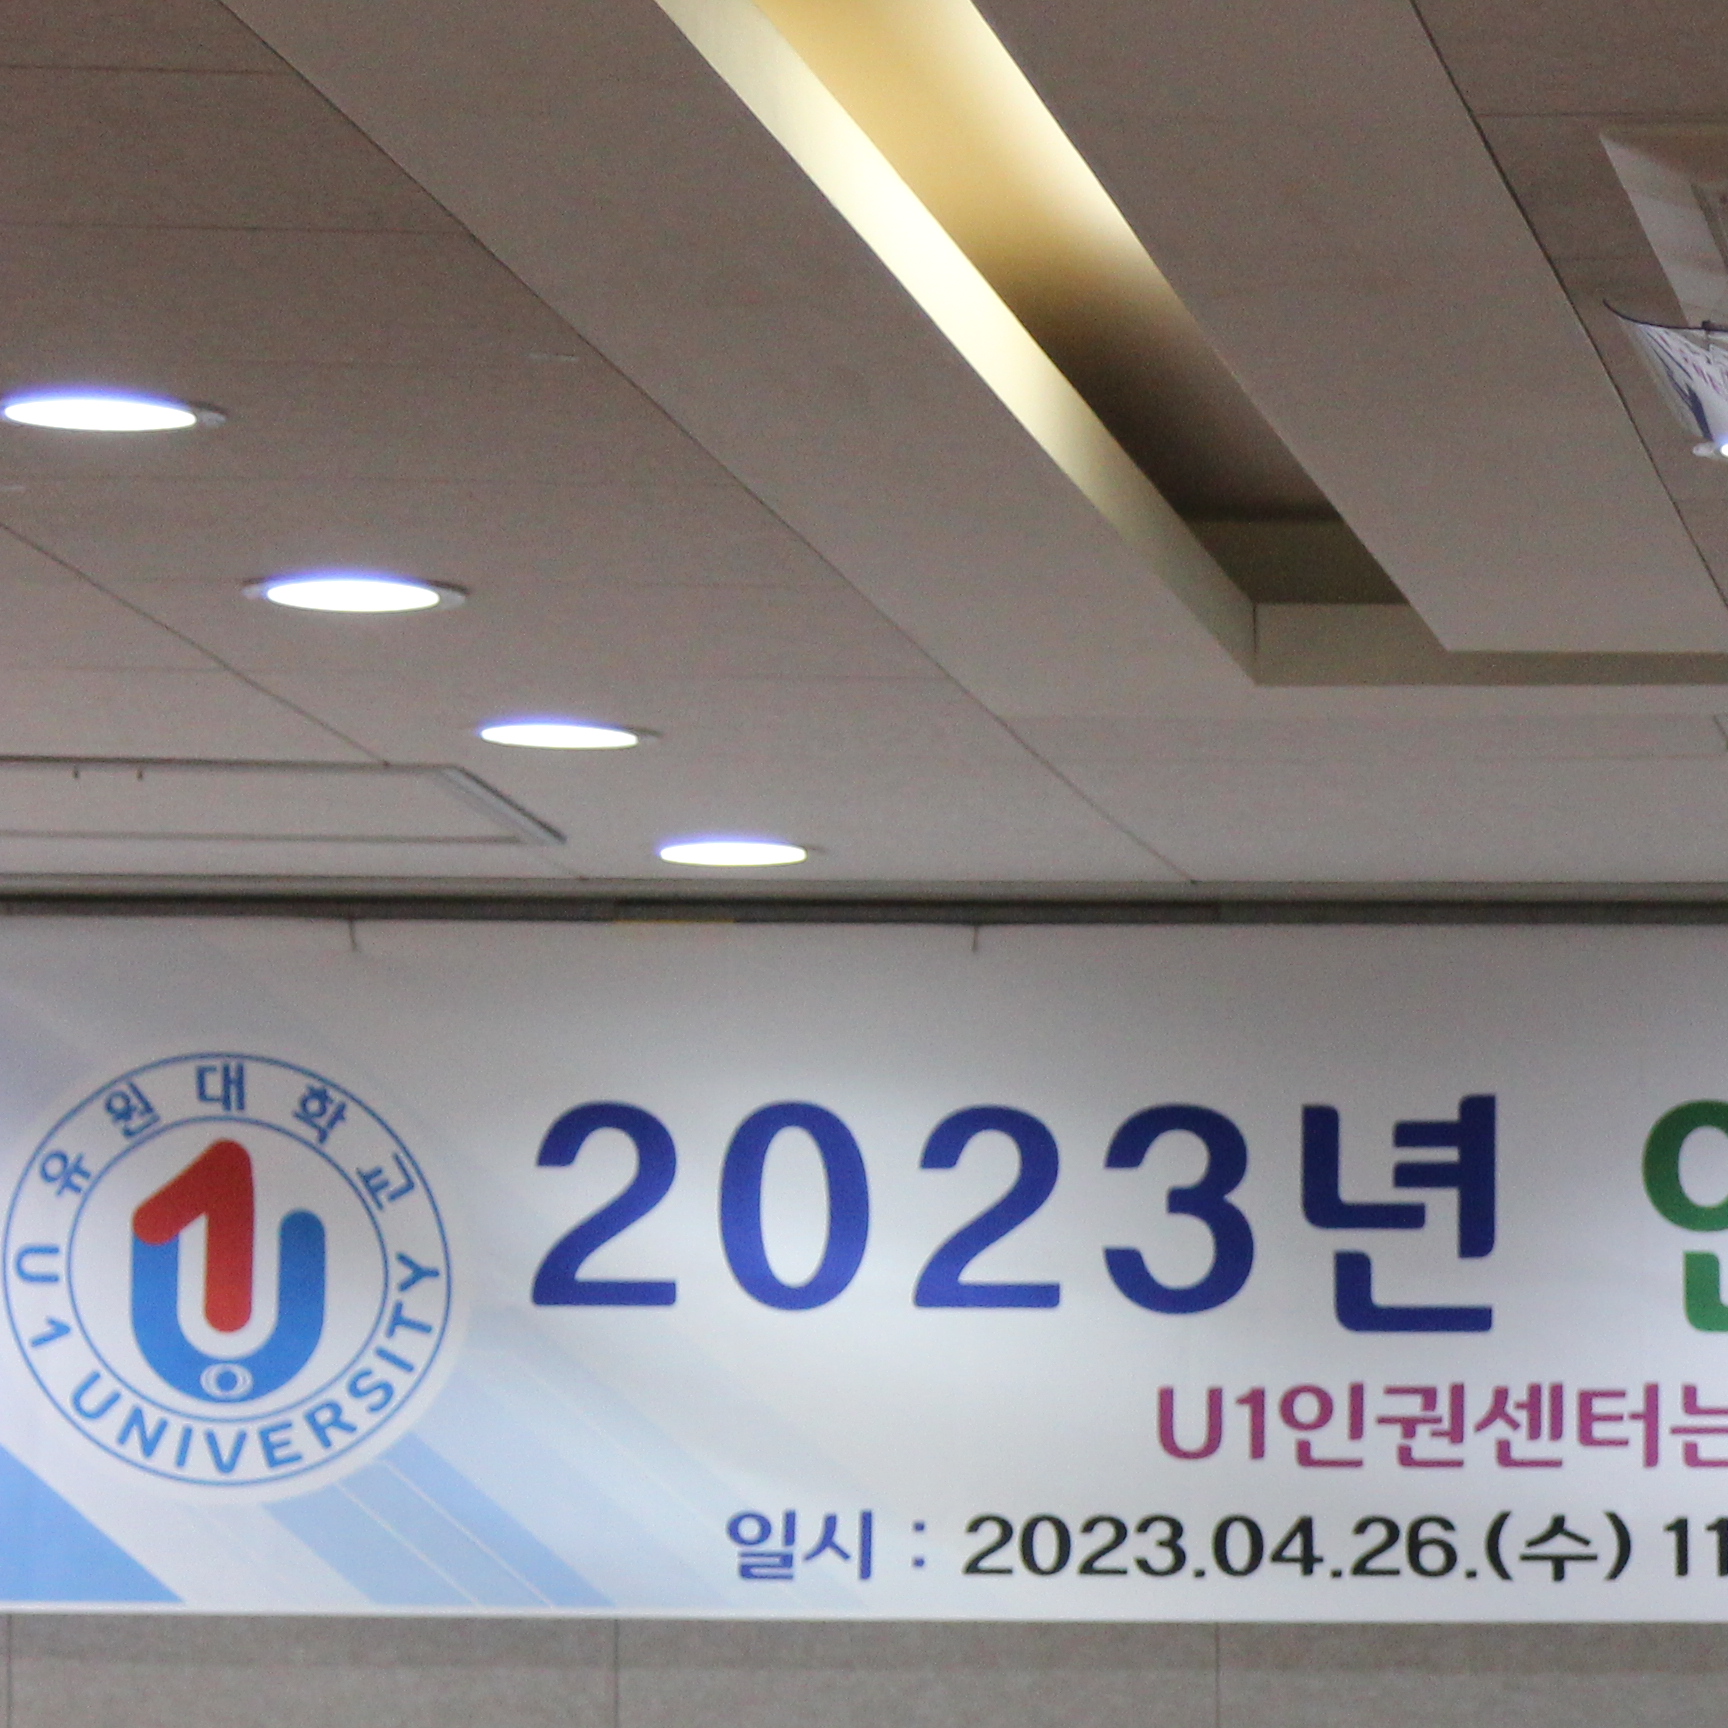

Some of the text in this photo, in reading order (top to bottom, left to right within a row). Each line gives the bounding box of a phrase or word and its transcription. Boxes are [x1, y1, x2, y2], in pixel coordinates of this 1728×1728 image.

[38, 1062, 416, 1212] 유원대학교
[530, 1093, 1498, 1334] 2023년
[70, 1252, 440, 1474] UNIVERSITY
[963, 1510, 1633, 1583] 2023.04.26.(수)
